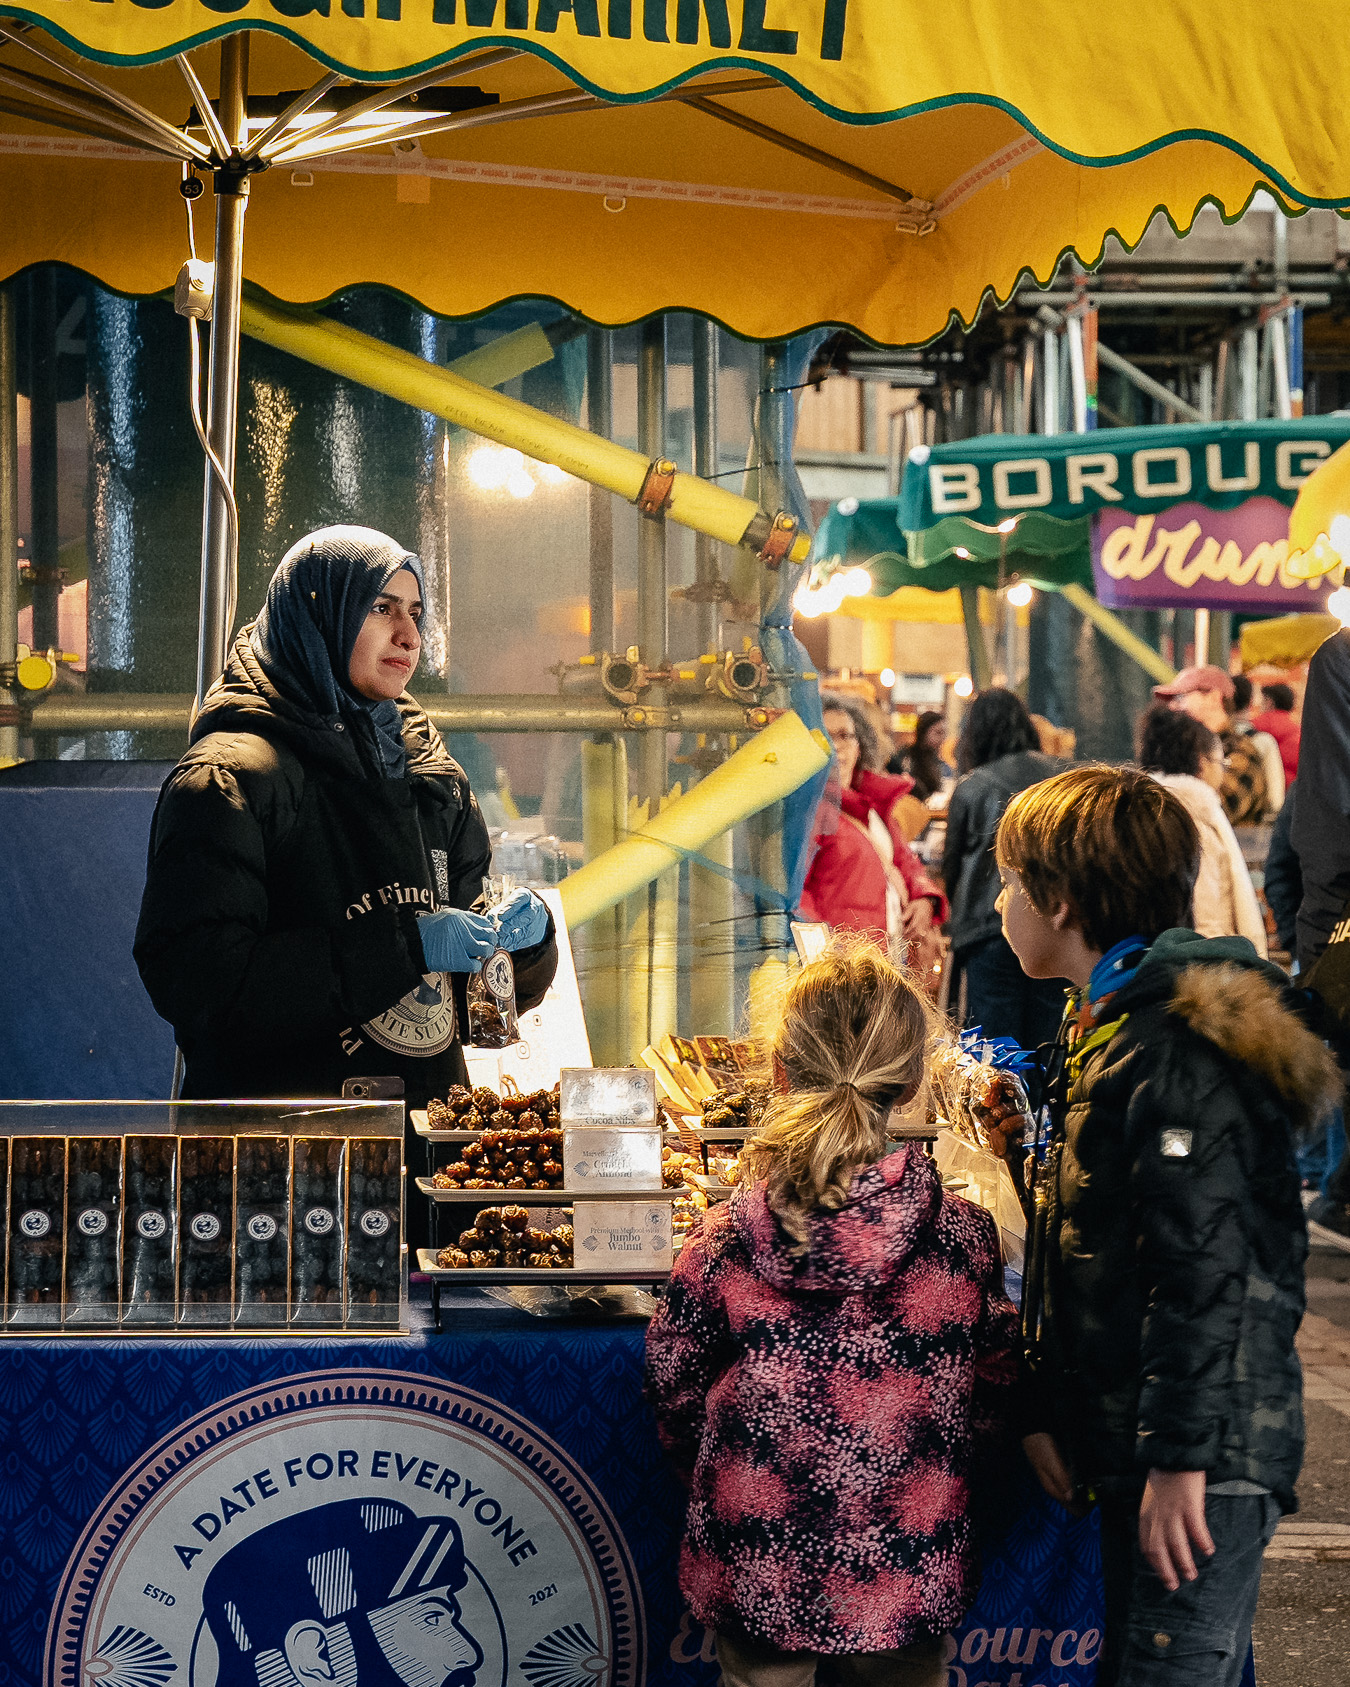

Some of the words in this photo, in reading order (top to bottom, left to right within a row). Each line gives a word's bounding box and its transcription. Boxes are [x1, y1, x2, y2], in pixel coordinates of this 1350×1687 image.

[184, 184, 200, 194] 53
[608, 1242, 643, 1251] Walnut
[609, 1232, 641, 1242] Jumbo
[173, 1544, 204, 1571] A
[191, 1468, 280, 1542] DATE
[283, 1449, 359, 1487] FOR
[370, 1450, 538, 1568] EVERYONE
[142, 1582, 177, 1607] ESTD
[528, 1582, 558, 1606] 2021
[940, 1624, 1104, 1667] ource
